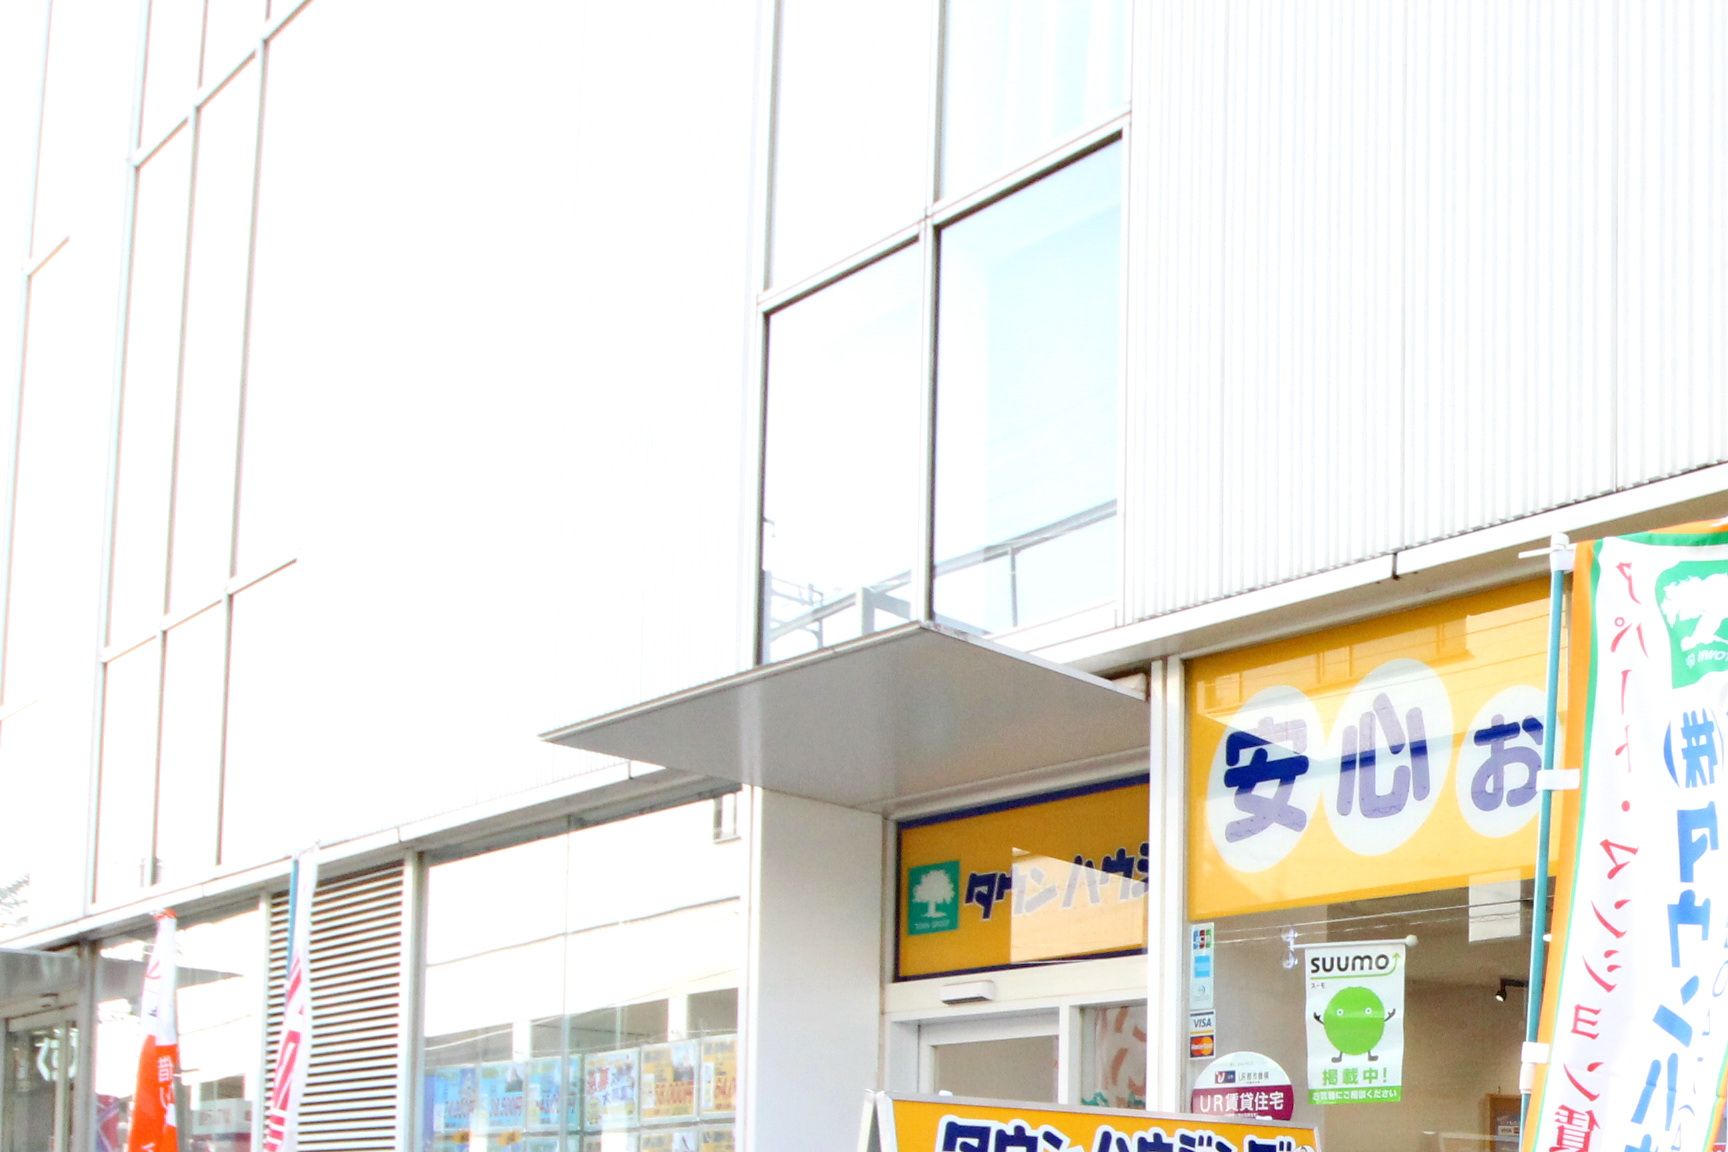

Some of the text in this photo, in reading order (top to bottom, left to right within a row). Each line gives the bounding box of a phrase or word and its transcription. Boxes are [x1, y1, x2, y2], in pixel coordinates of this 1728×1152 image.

[1193, 1018, 1212, 1028] VISA
[1200, 1090, 1284, 1112] UR賃貸住宅
